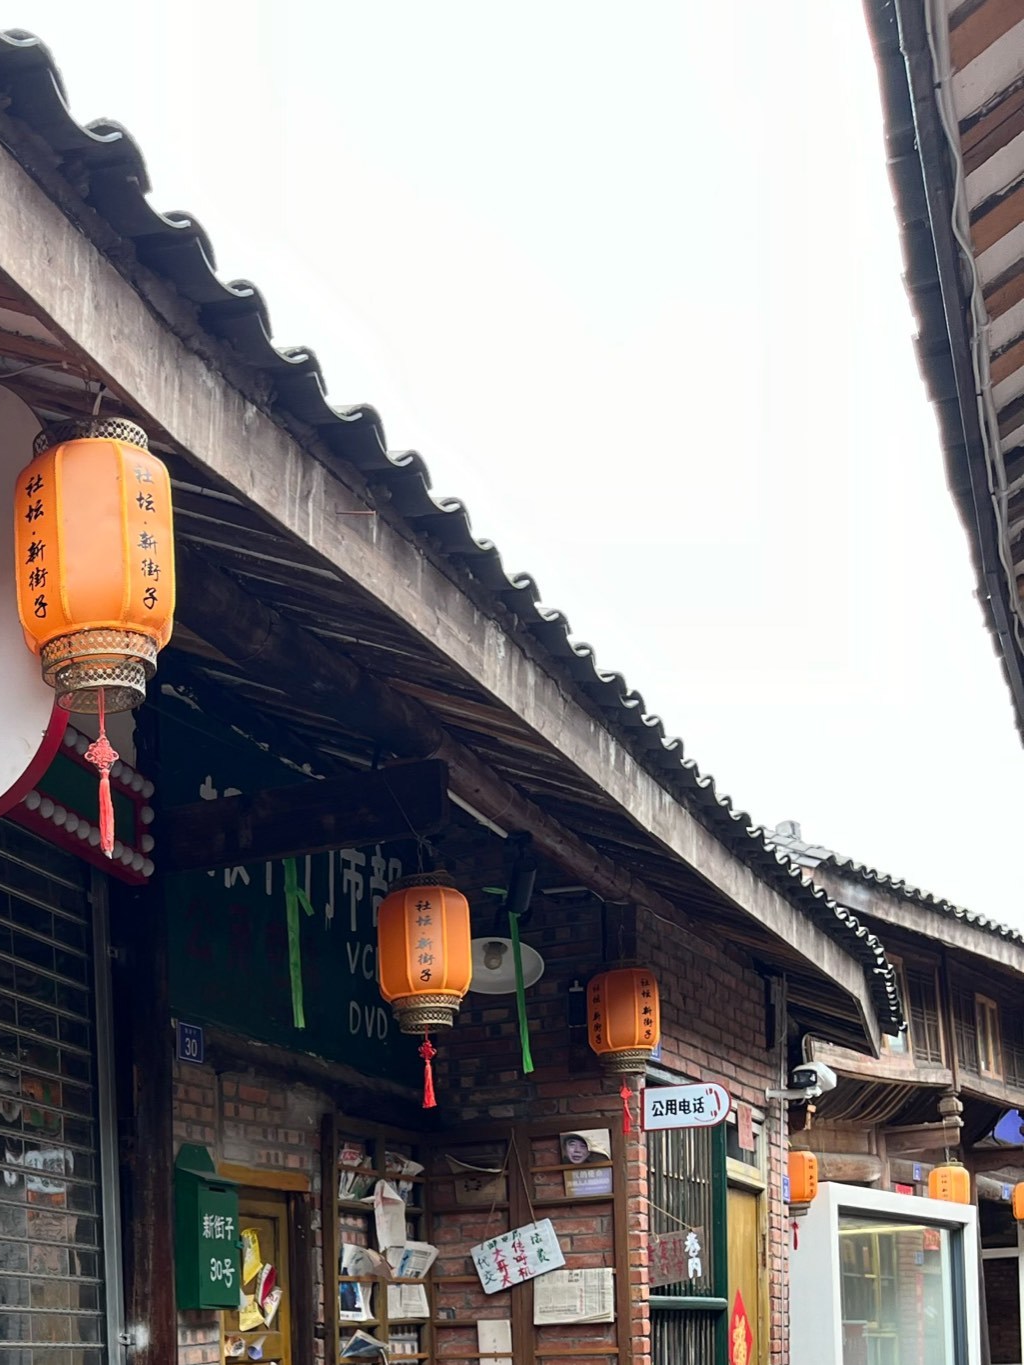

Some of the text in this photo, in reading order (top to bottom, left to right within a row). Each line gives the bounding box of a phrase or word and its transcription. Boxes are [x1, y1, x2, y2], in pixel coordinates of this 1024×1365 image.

[347, 941, 379, 982] VC
[349, 1001, 388, 1039] DVD
[185, 1037, 198, 1057] 30
[651, 1096, 705, 1117] 公用电话
[202, 1213, 235, 1240] 新街子
[209, 1257, 236, 1288] 30号
